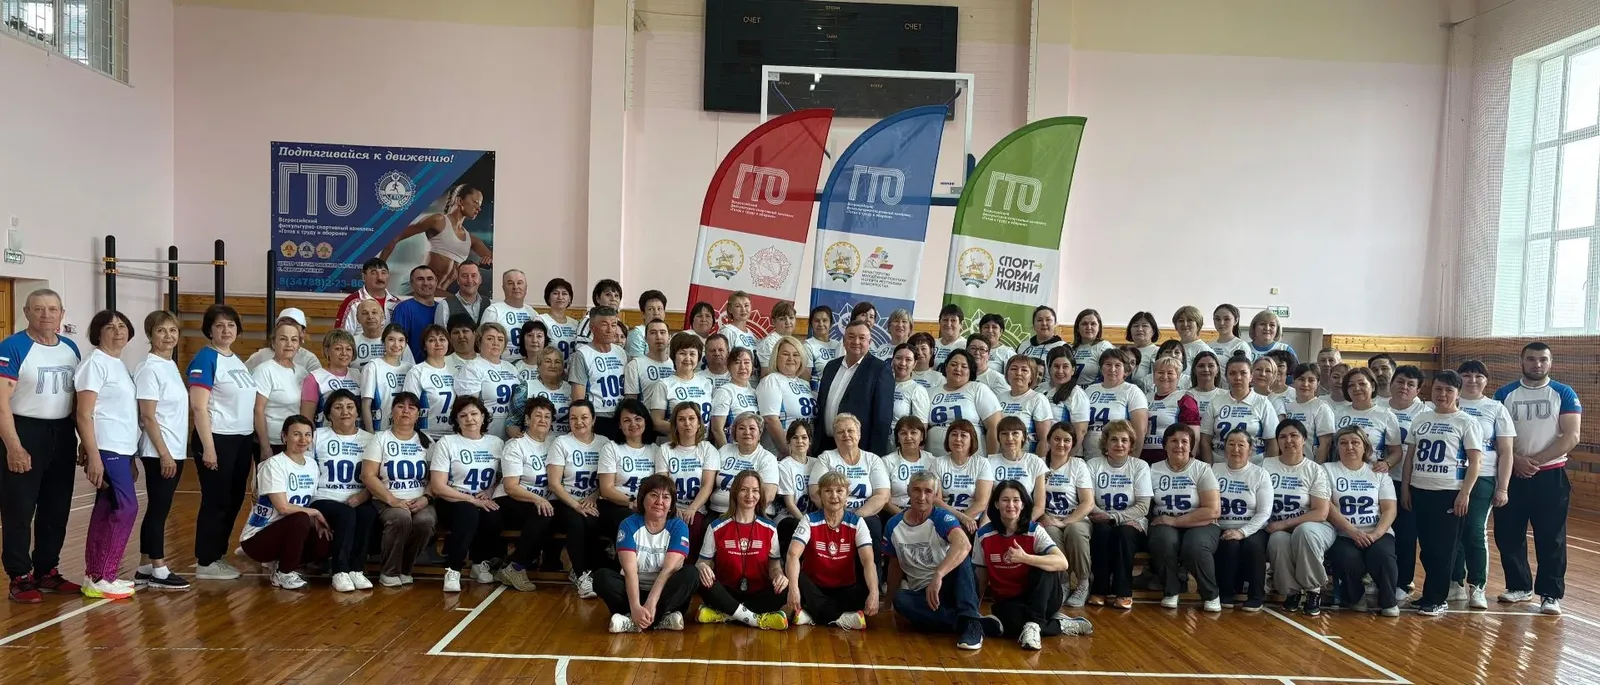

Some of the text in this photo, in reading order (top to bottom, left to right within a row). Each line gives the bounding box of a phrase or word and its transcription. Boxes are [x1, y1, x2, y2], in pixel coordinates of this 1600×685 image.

[743, 16, 761, 24] СЧЕТ
[904, 22, 922, 31] СЧЕТ
[278, 146, 454, 164] Подтягивайся к движению!
[278, 162, 358, 217] ГТО
[732, 163, 790, 206] ГТО
[848, 164, 906, 206] ГТО
[984, 170, 1043, 214] ГТО
[998, 255, 1035, 270] СПОРТ
[996, 266, 1041, 284] НОРМА
[994, 278, 1039, 295] ЖИЗНИ
[36, 366, 75, 394] ГТО
[931, 405, 963, 424] 61
[1512, 400, 1551, 421] ГТО
[1416, 438, 1446, 463] 80
[384, 459, 428, 482] 100
[463, 467, 495, 491] 49
[1427, 464, 1449, 474] 2016
[388, 480, 407, 490] УФА
[675, 476, 701, 500] 46
[1101, 492, 1129, 511] 16
[1161, 494, 1192, 510] 15
[1338, 495, 1374, 516] 62
